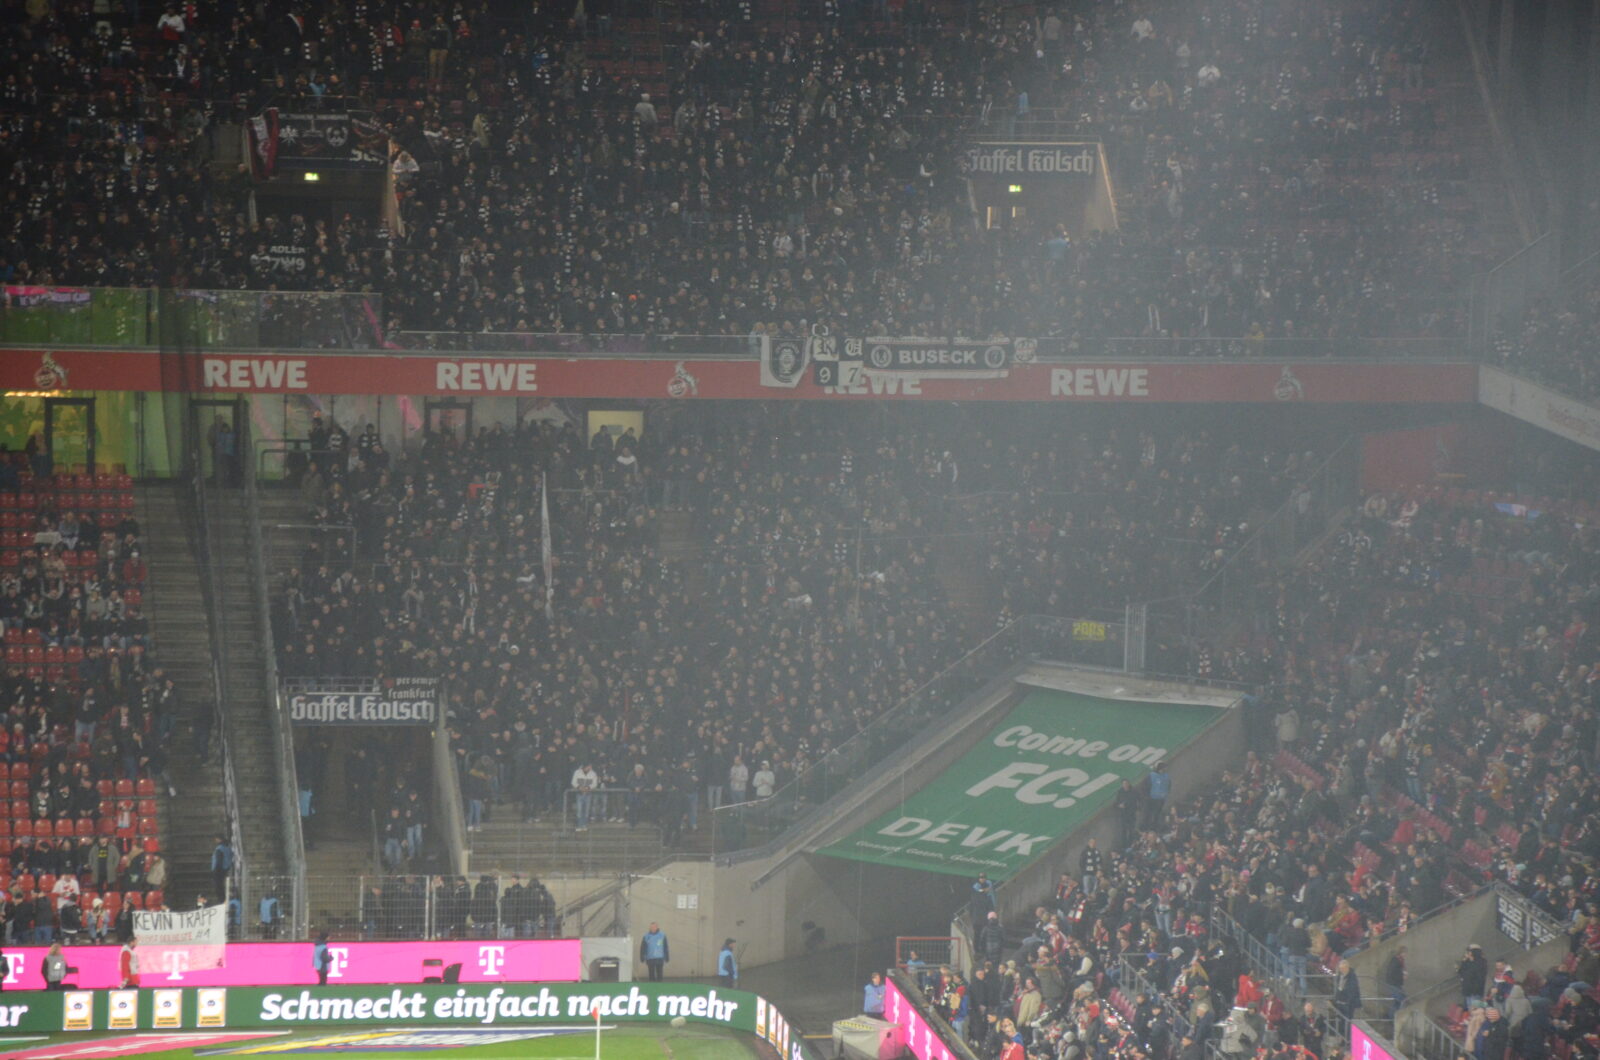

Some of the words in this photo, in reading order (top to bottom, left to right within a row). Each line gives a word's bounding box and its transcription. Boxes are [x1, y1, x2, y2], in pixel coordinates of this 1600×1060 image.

[898, 350, 977, 364] BUSECK
[203, 359, 308, 389] REWE
[436, 361, 538, 391] REWE
[1050, 368, 1149, 396] REWE
[993, 725, 1110, 758] Come
[1107, 744, 1167, 768] on
[965, 762, 1120, 809] FC!
[876, 816, 1053, 856] DEVK
[134, 912, 173, 931] KEVIN
[177, 908, 217, 929] TRAPP
[259, 989, 426, 1021] Schmeckt
[433, 988, 559, 1023] einfach
[567, 986, 650, 1017] nach
[657, 989, 738, 1022] mehr
